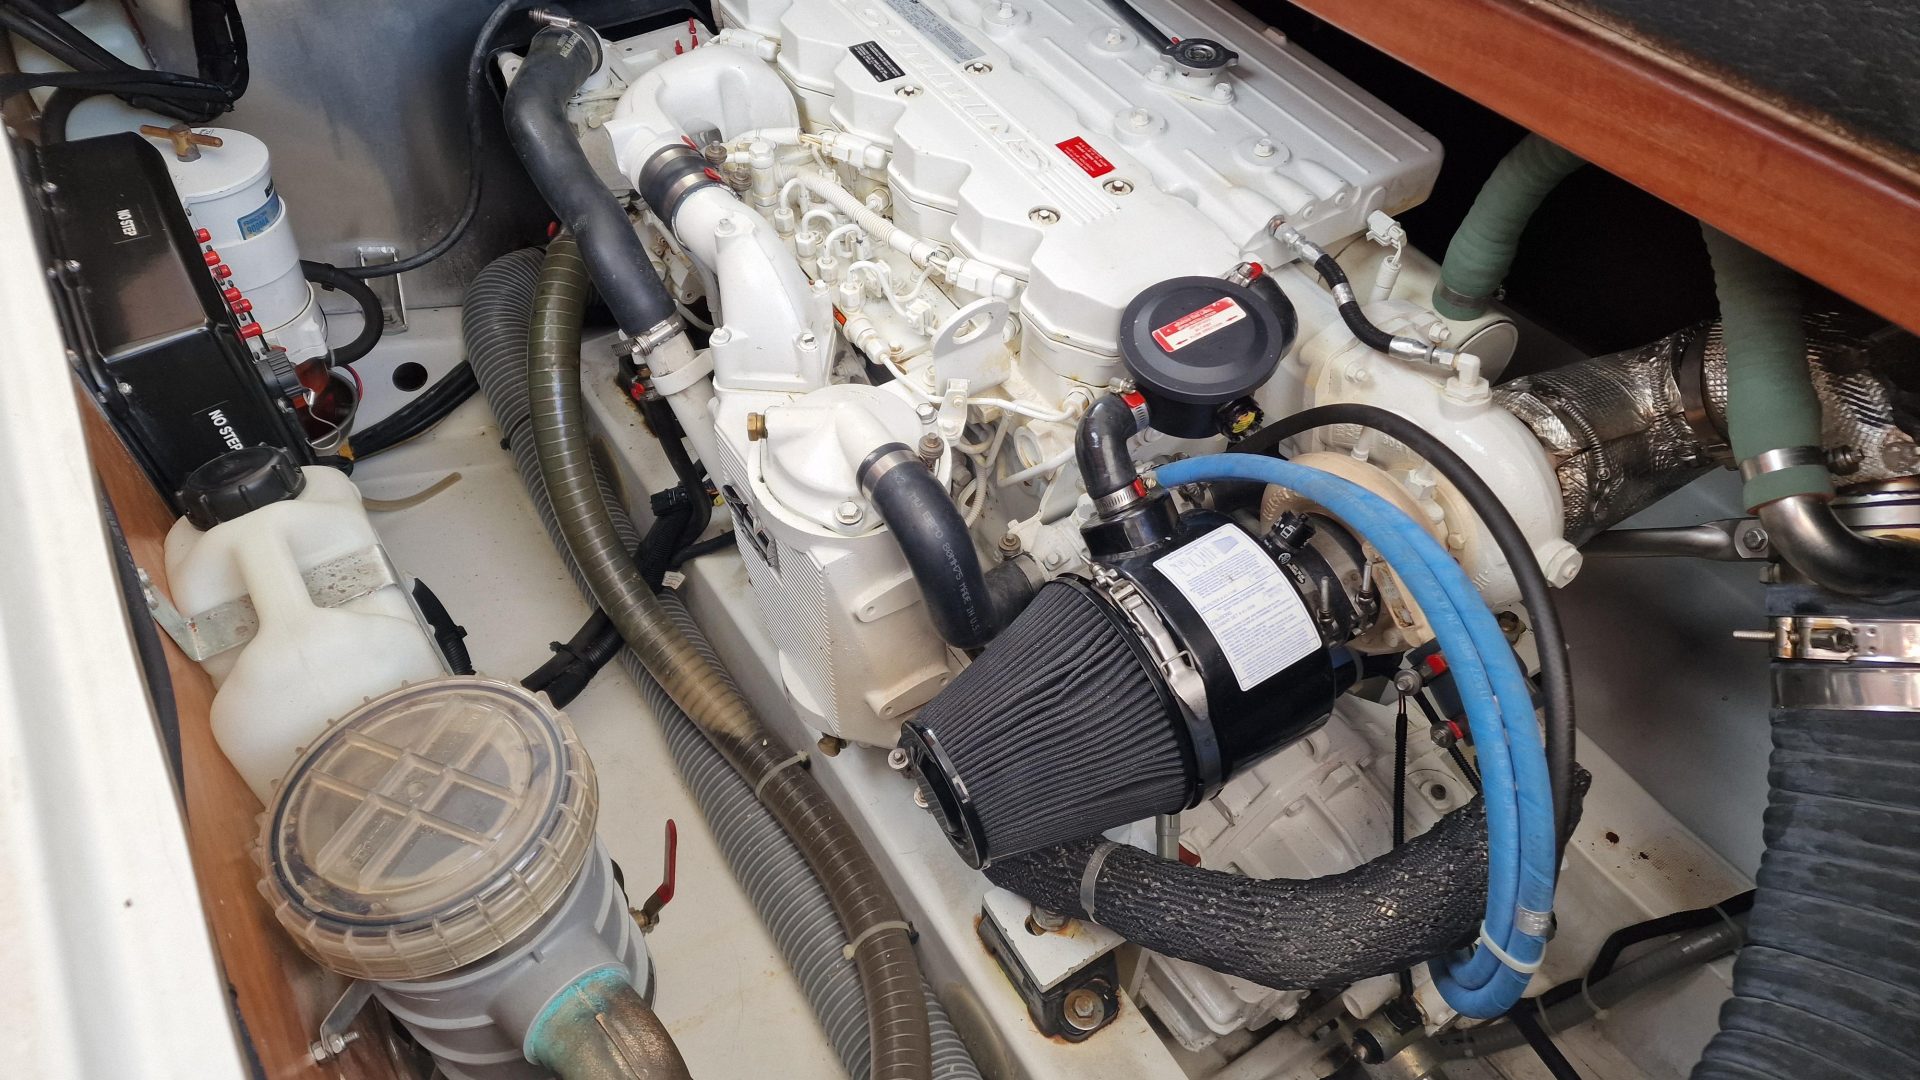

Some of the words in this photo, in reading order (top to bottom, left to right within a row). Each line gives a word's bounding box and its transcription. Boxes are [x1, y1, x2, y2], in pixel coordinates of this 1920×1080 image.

[116, 208, 131, 220] NO
[120, 219, 138, 237] STEP
[208, 409, 228, 427] NO
[219, 424, 244, 451] STEP
[959, 581, 972, 604] MADE
